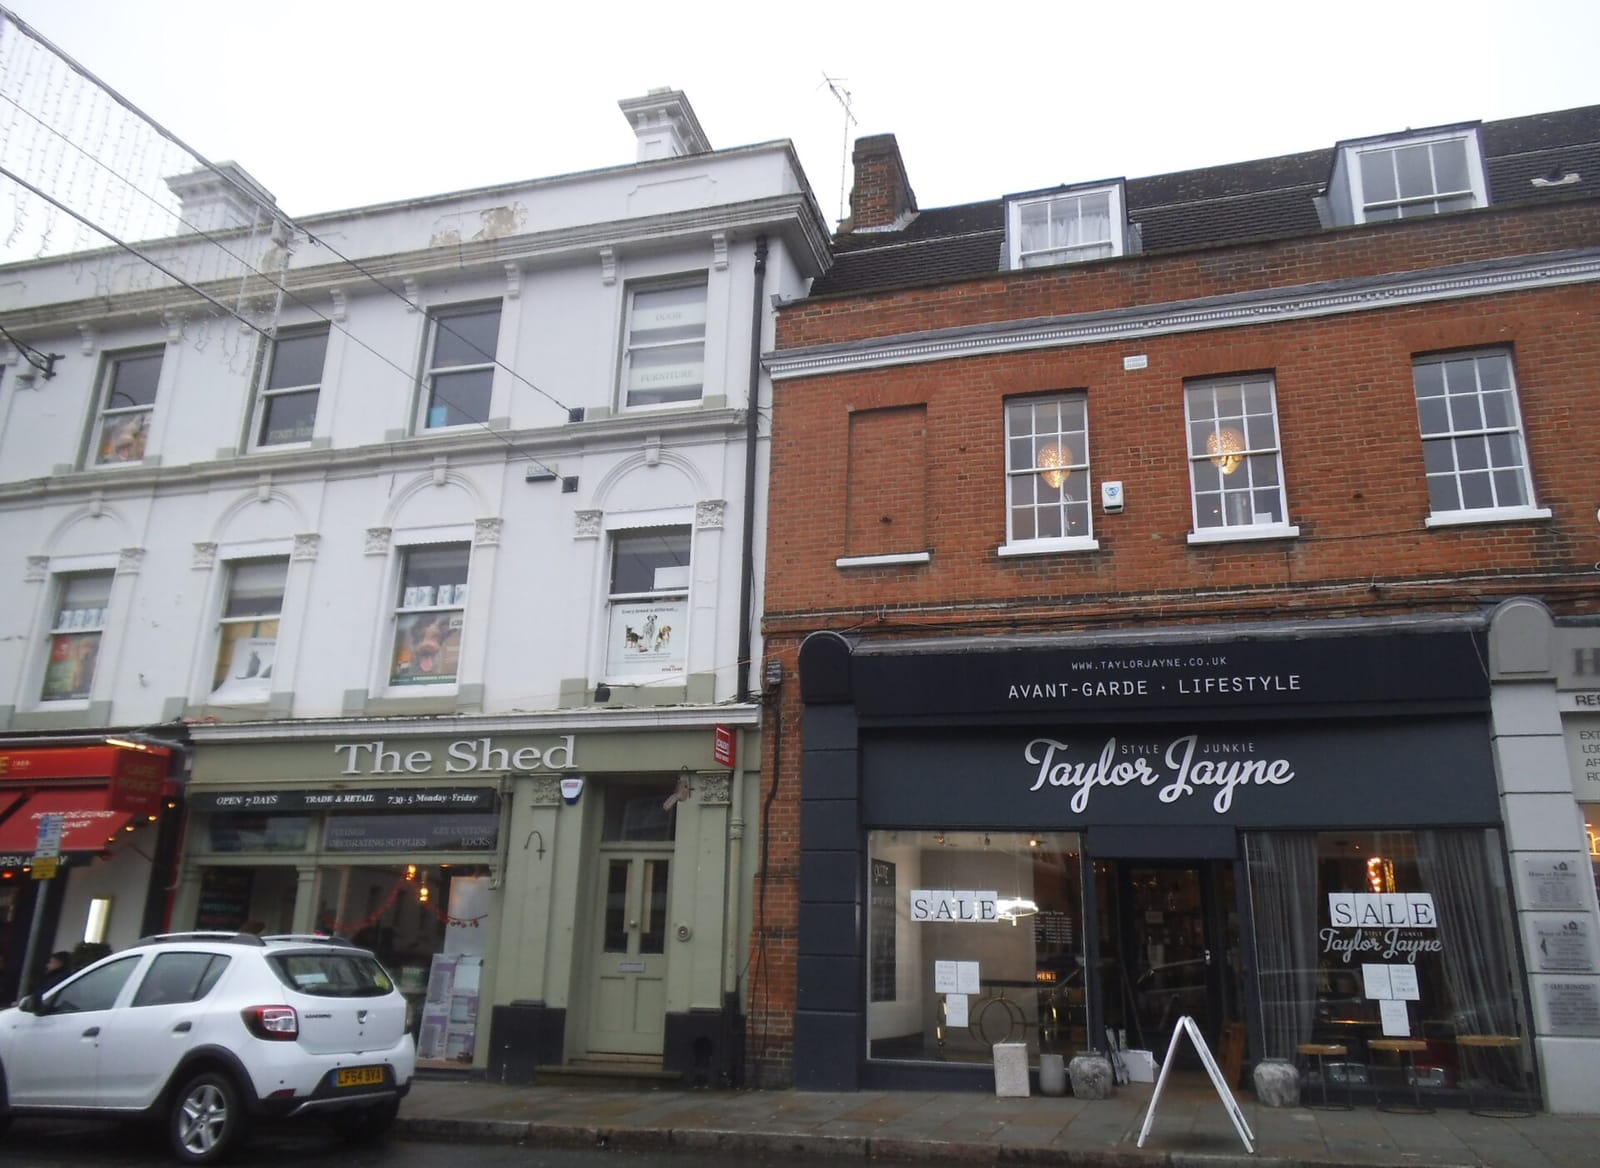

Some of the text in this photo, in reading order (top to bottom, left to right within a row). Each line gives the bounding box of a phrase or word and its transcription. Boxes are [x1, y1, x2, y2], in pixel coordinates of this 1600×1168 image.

[1072, 656, 1227, 671] WWW.TAYLORJAYNE.CO.UK
[1008, 675, 1302, 699] AVANT-GARDE LIFESTYLE
[334, 735, 579, 775] The Shed
[1121, 742, 1255, 755] STYLE JUNKIE
[1024, 734, 1295, 814] Taylor Jayne
[216, 795, 279, 807] OPEN 7 DAYS
[304, 794, 375, 804] TRADE & RETAIL
[416, 793, 447, 804] Monday
[451, 793, 479, 804] Friday
[461, 838, 490, 847] LOCKS
[914, 898, 996, 920] SALE
[1335, 902, 1435, 925] SALE
[1319, 928, 1442, 963] Taylor Jayne
